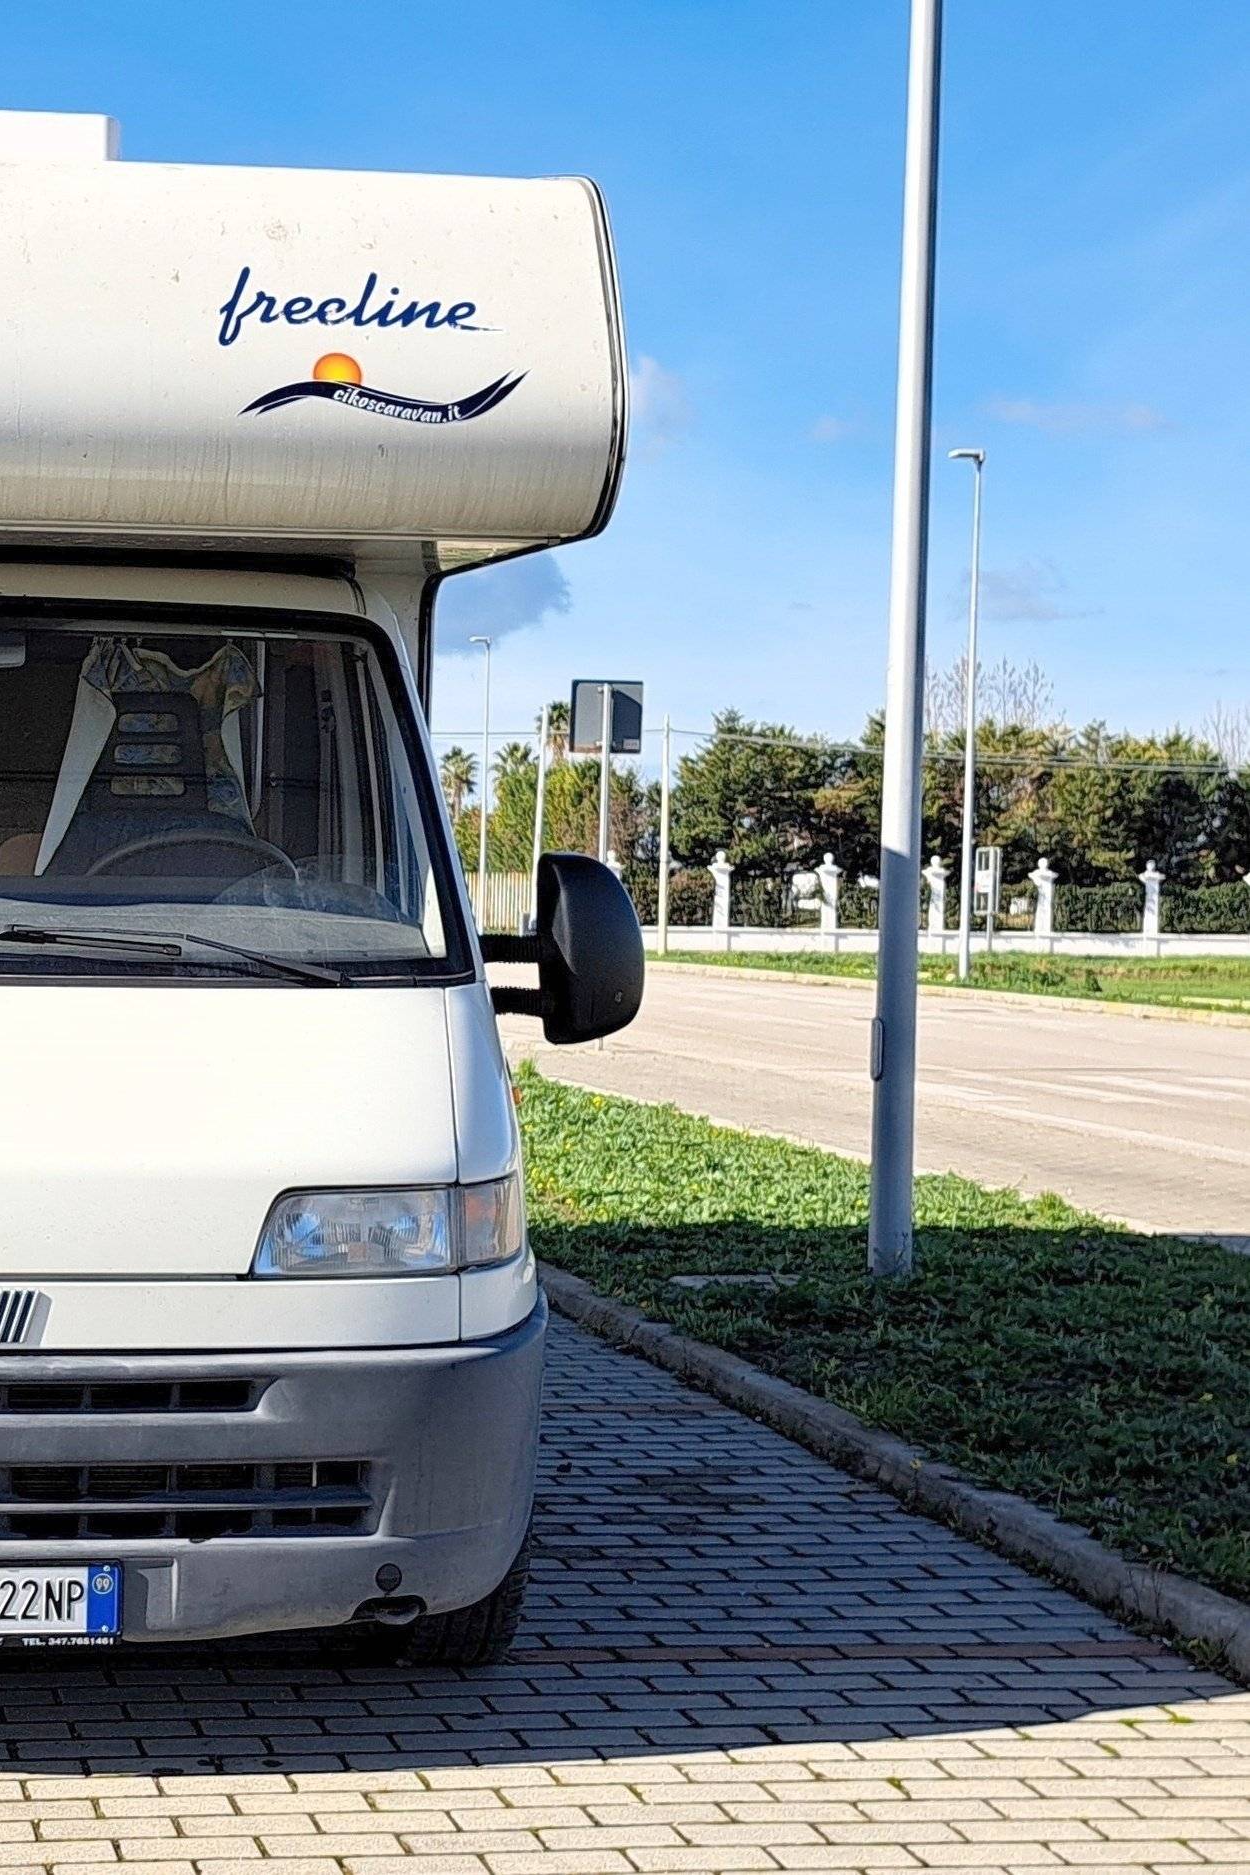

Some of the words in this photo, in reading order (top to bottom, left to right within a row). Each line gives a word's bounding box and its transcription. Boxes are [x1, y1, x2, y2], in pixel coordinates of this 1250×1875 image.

[218, 266, 504, 346] freeline
[333, 388, 462, 423] cikoscaravan.it
[22, 1637, 46, 1647] TEL.
